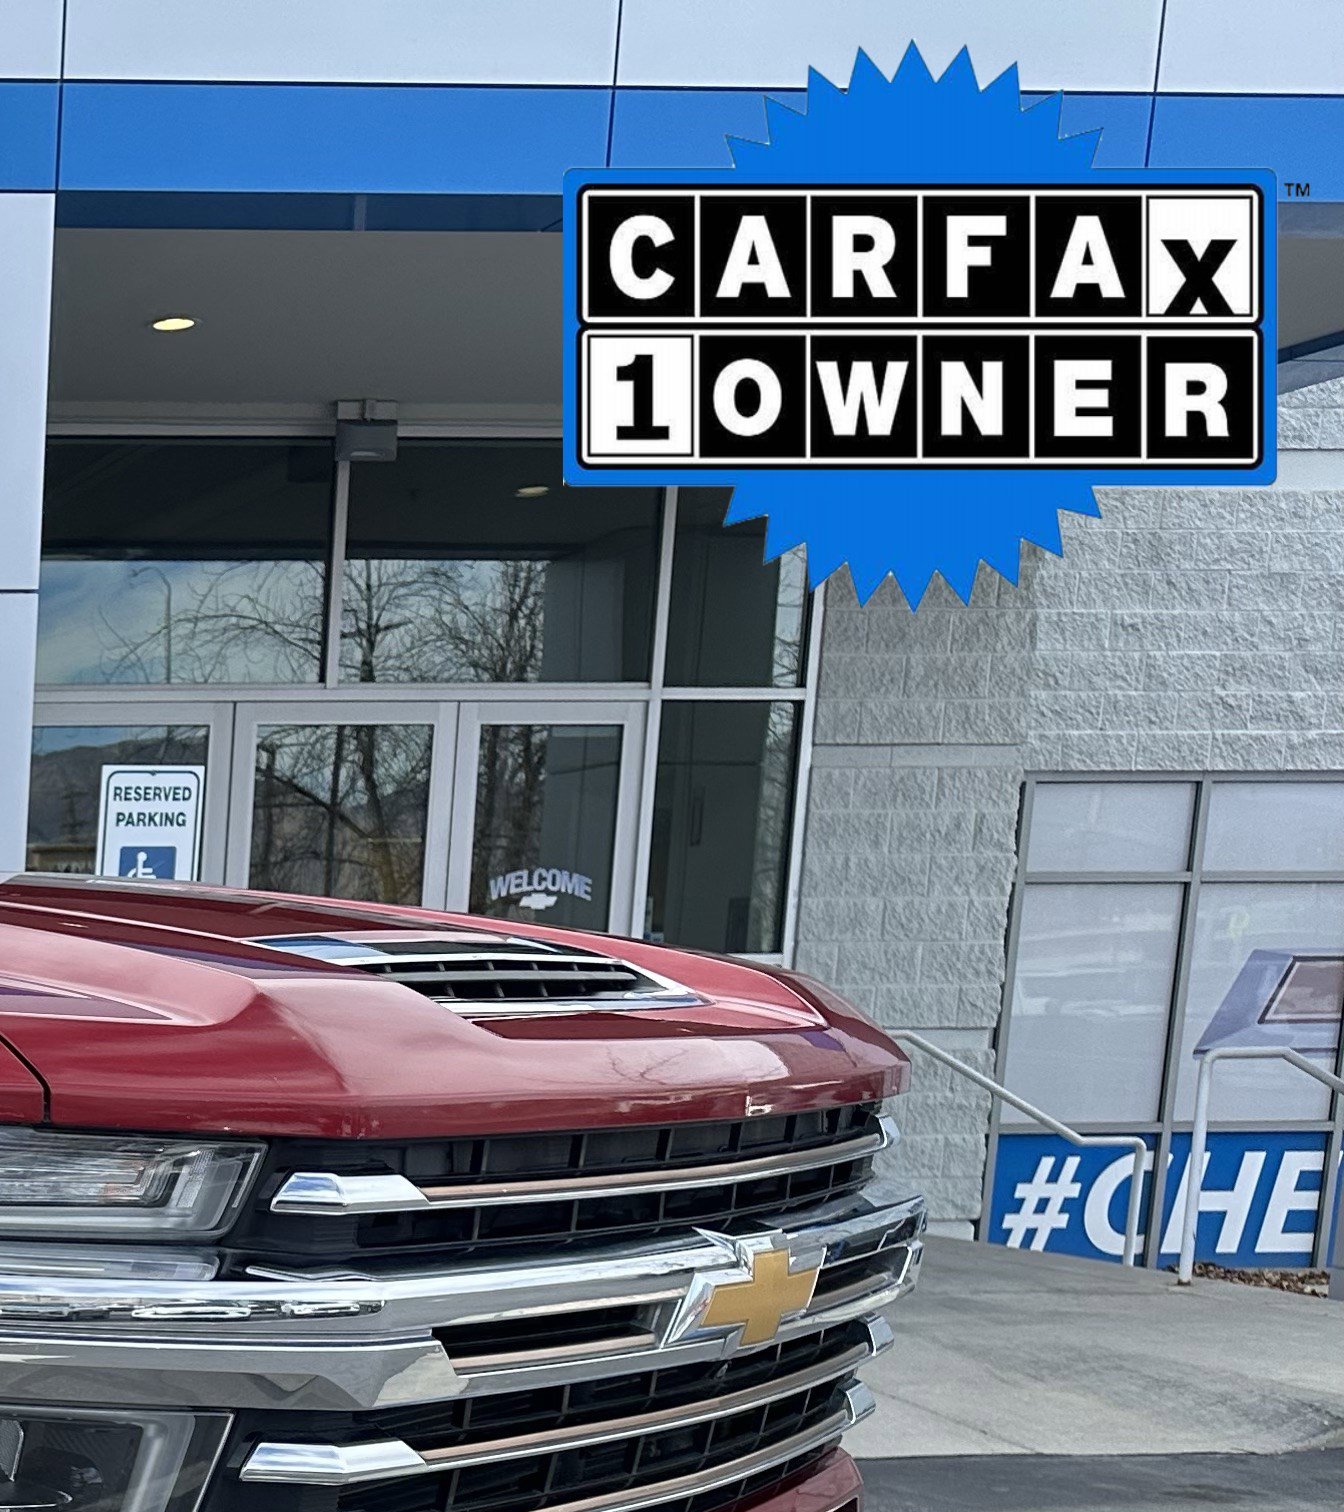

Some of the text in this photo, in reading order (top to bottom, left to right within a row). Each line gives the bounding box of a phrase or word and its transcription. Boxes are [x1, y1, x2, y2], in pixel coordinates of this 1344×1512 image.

[113, 786, 192, 802] RESERVED
[115, 812, 187, 827] PARKING
[489, 867, 593, 901] WELCOME
